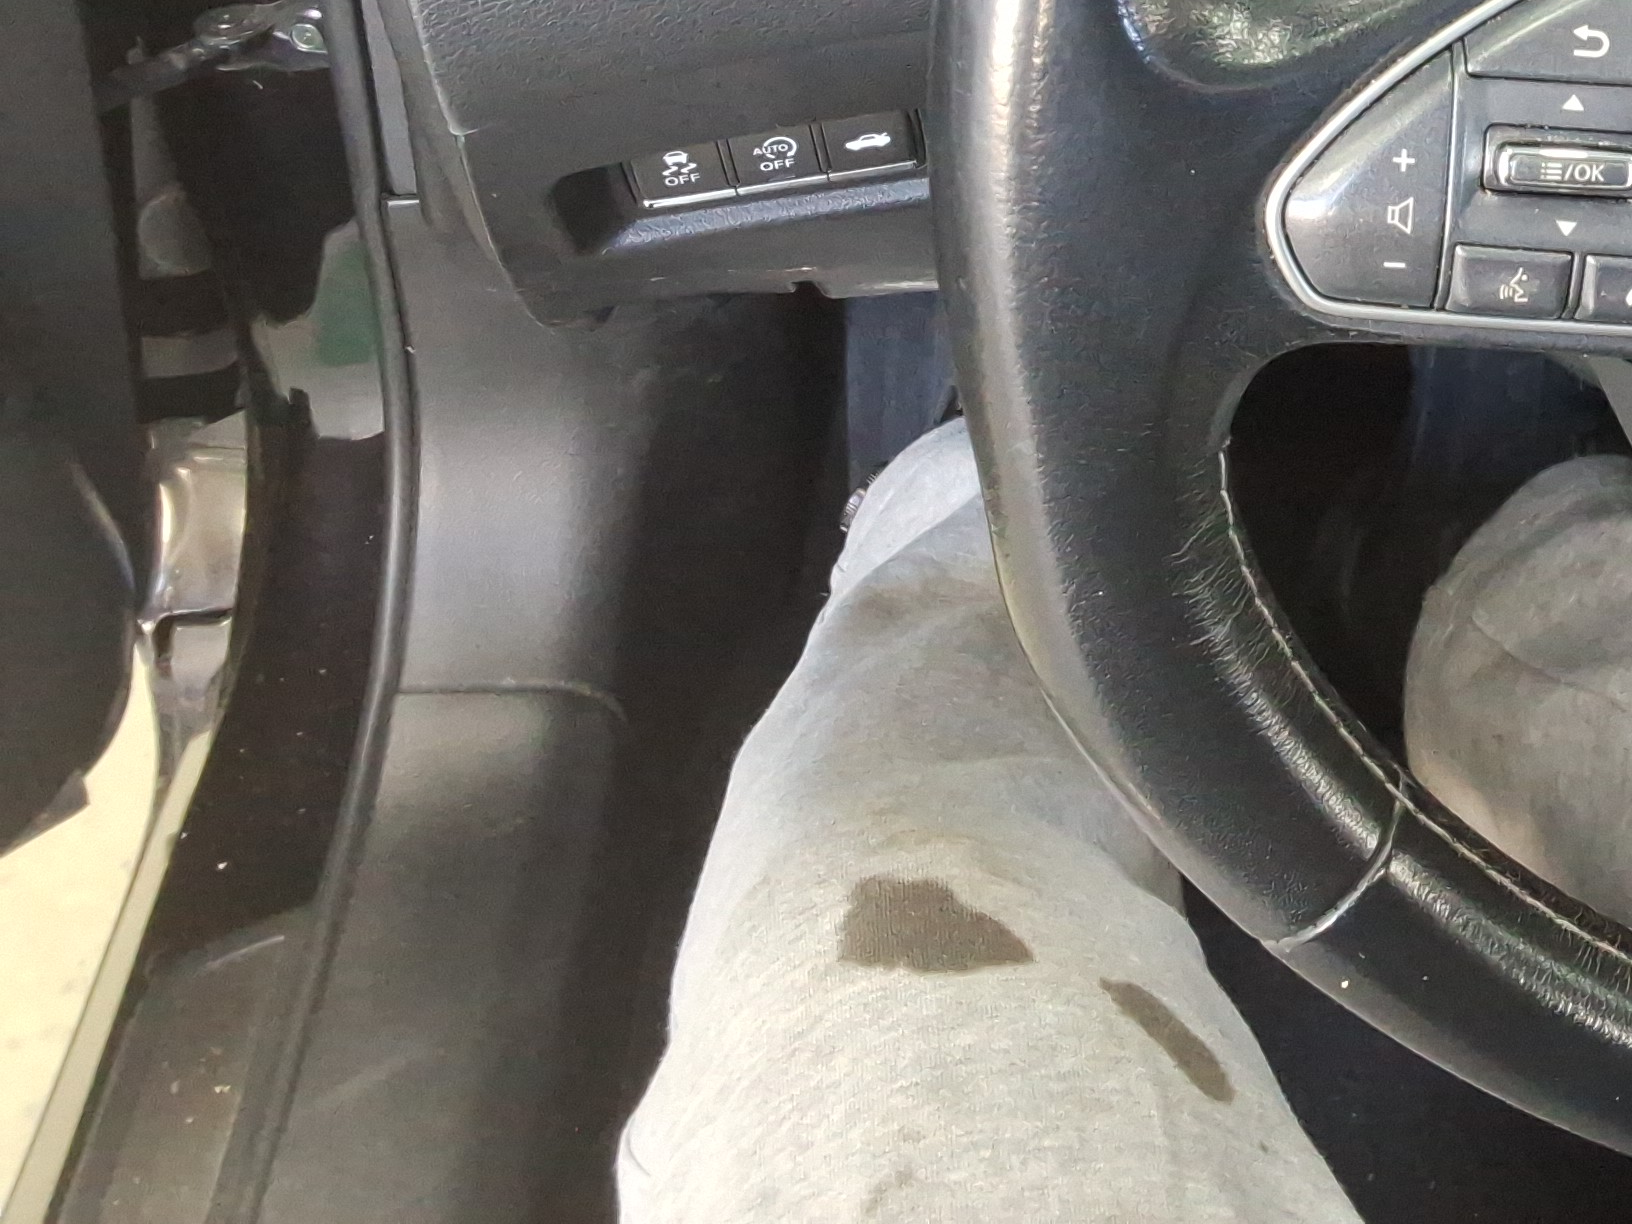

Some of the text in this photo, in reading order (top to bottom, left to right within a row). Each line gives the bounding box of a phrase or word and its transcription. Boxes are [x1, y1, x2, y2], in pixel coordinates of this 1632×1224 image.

[753, 143, 788, 156] AUTO
[759, 158, 795, 172] OFF
[665, 174, 700, 186] OFF
